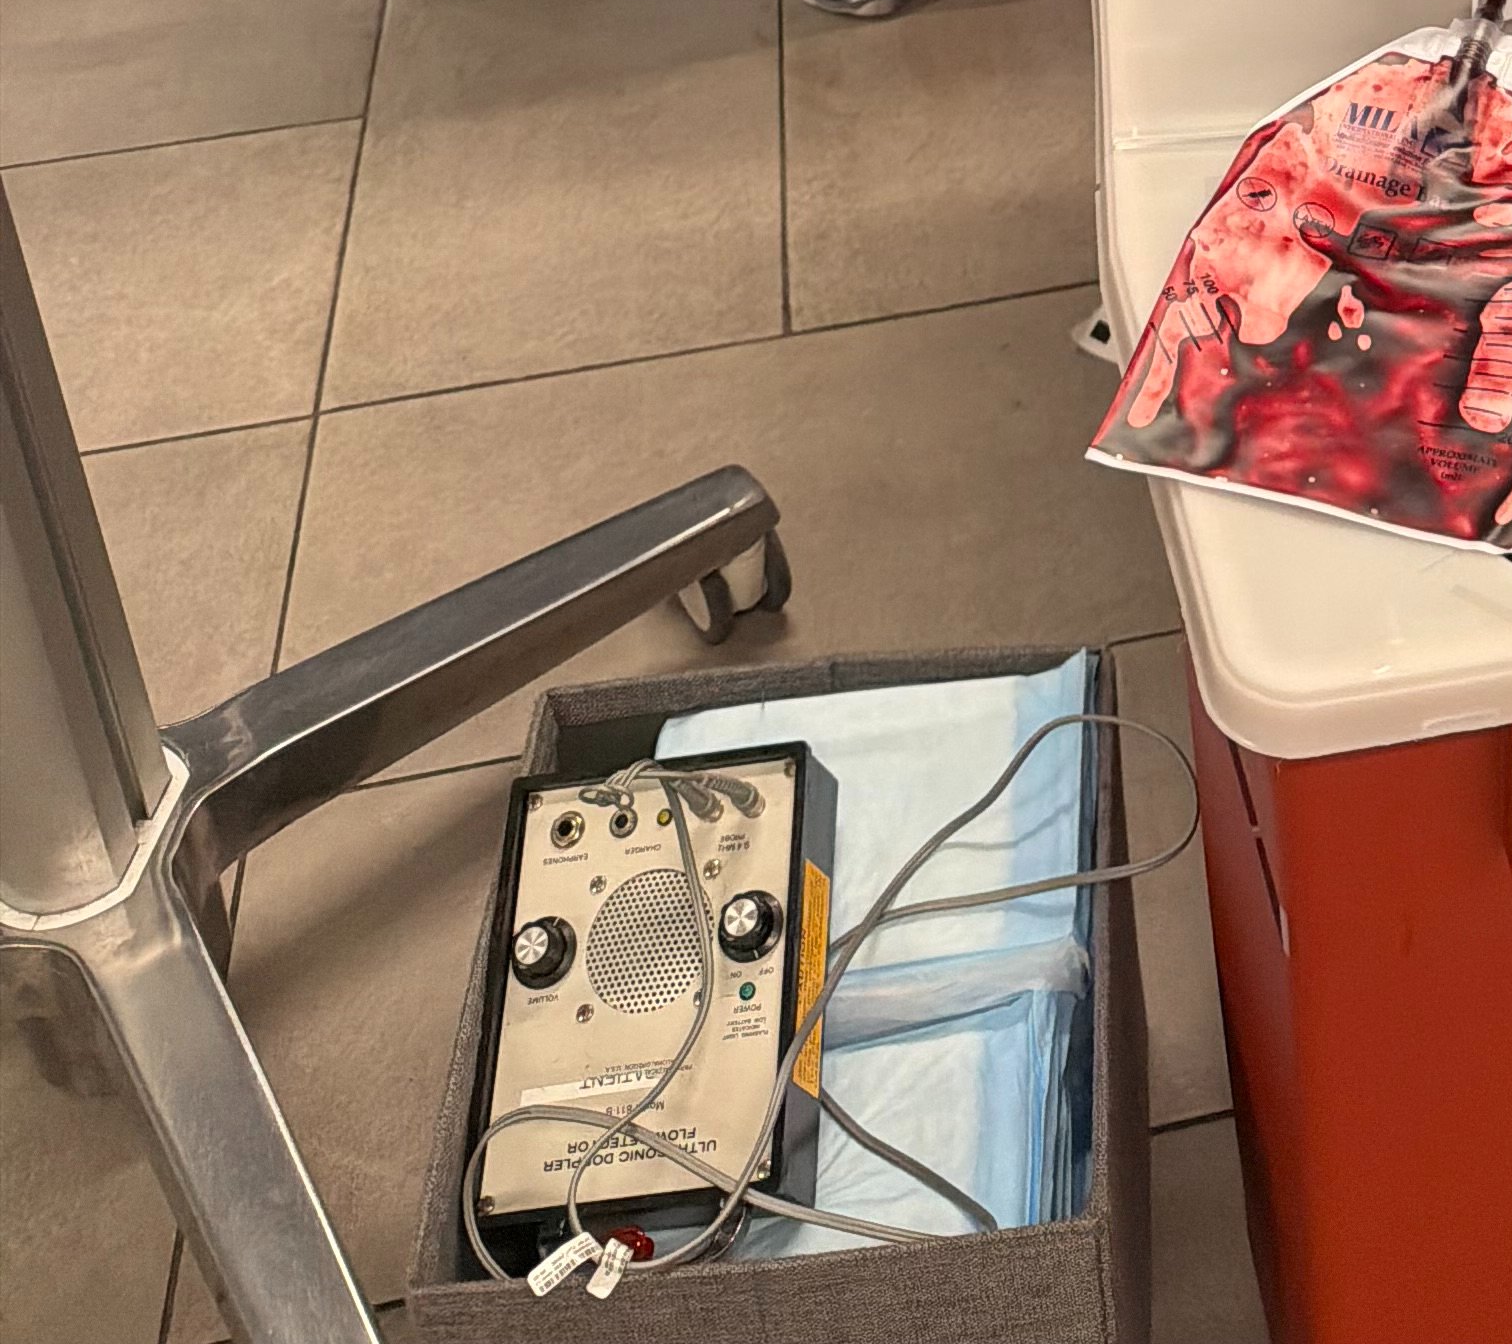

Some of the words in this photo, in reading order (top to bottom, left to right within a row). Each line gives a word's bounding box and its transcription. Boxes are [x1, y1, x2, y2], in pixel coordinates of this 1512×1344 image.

[1183, 279, 1199, 296] 75
[1200, 272, 1219, 296] 100
[1163, 286, 1179, 302] 50
[720, 833, 746, 843] PROBE
[625, 844, 661, 855] CHARGER
[543, 853, 589, 866] EARPHONES
[730, 971, 742, 979] ON
[758, 966, 774, 976] OFF
[528, 994, 559, 1006] VOLUME
[733, 1003, 762, 1014] POWER
